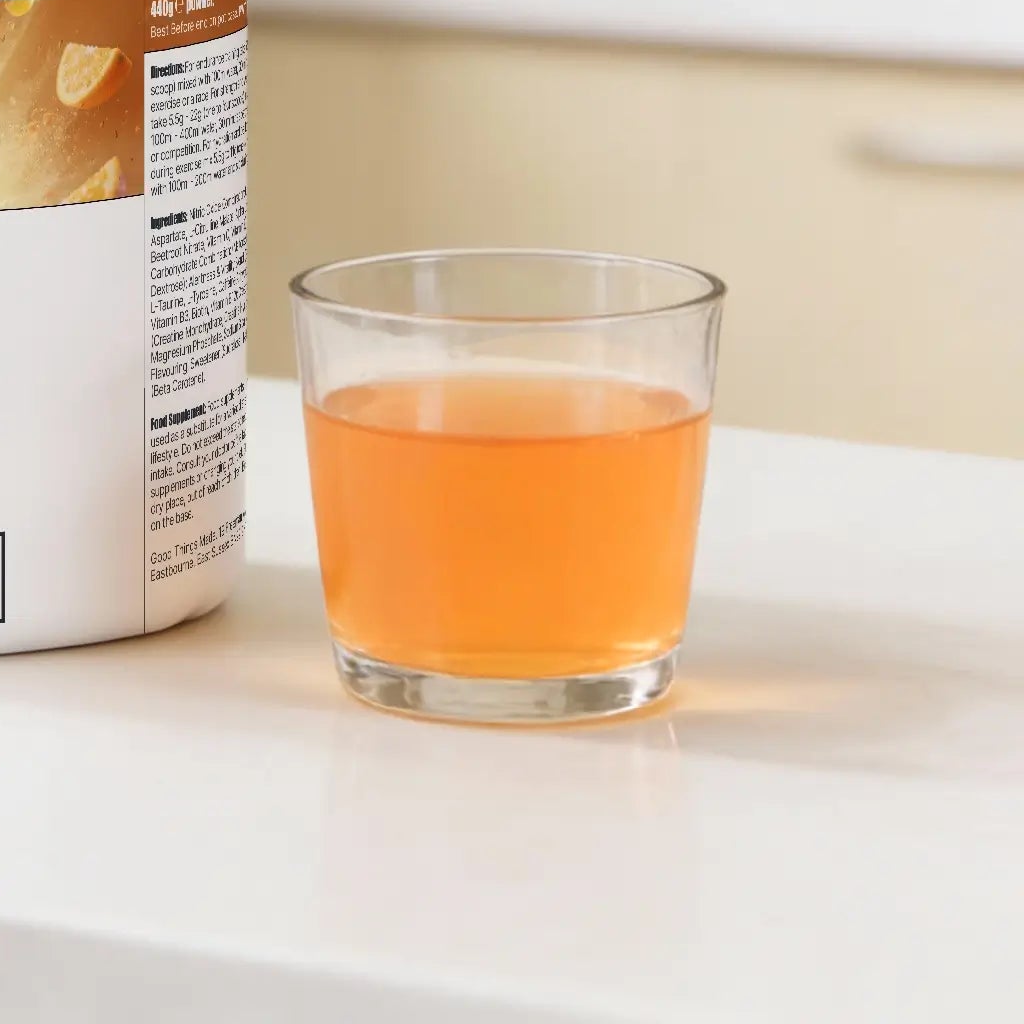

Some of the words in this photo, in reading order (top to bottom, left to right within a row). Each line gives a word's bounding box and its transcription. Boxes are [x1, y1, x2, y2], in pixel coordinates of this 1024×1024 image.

[150, 25, 169, 39] Best
[150, 63, 185, 79] Directions:
[150, 97, 181, 112] exercise
[150, 313, 178, 330] Vitamin
[150, 415, 168, 431] Food
[150, 432, 170, 447] used
